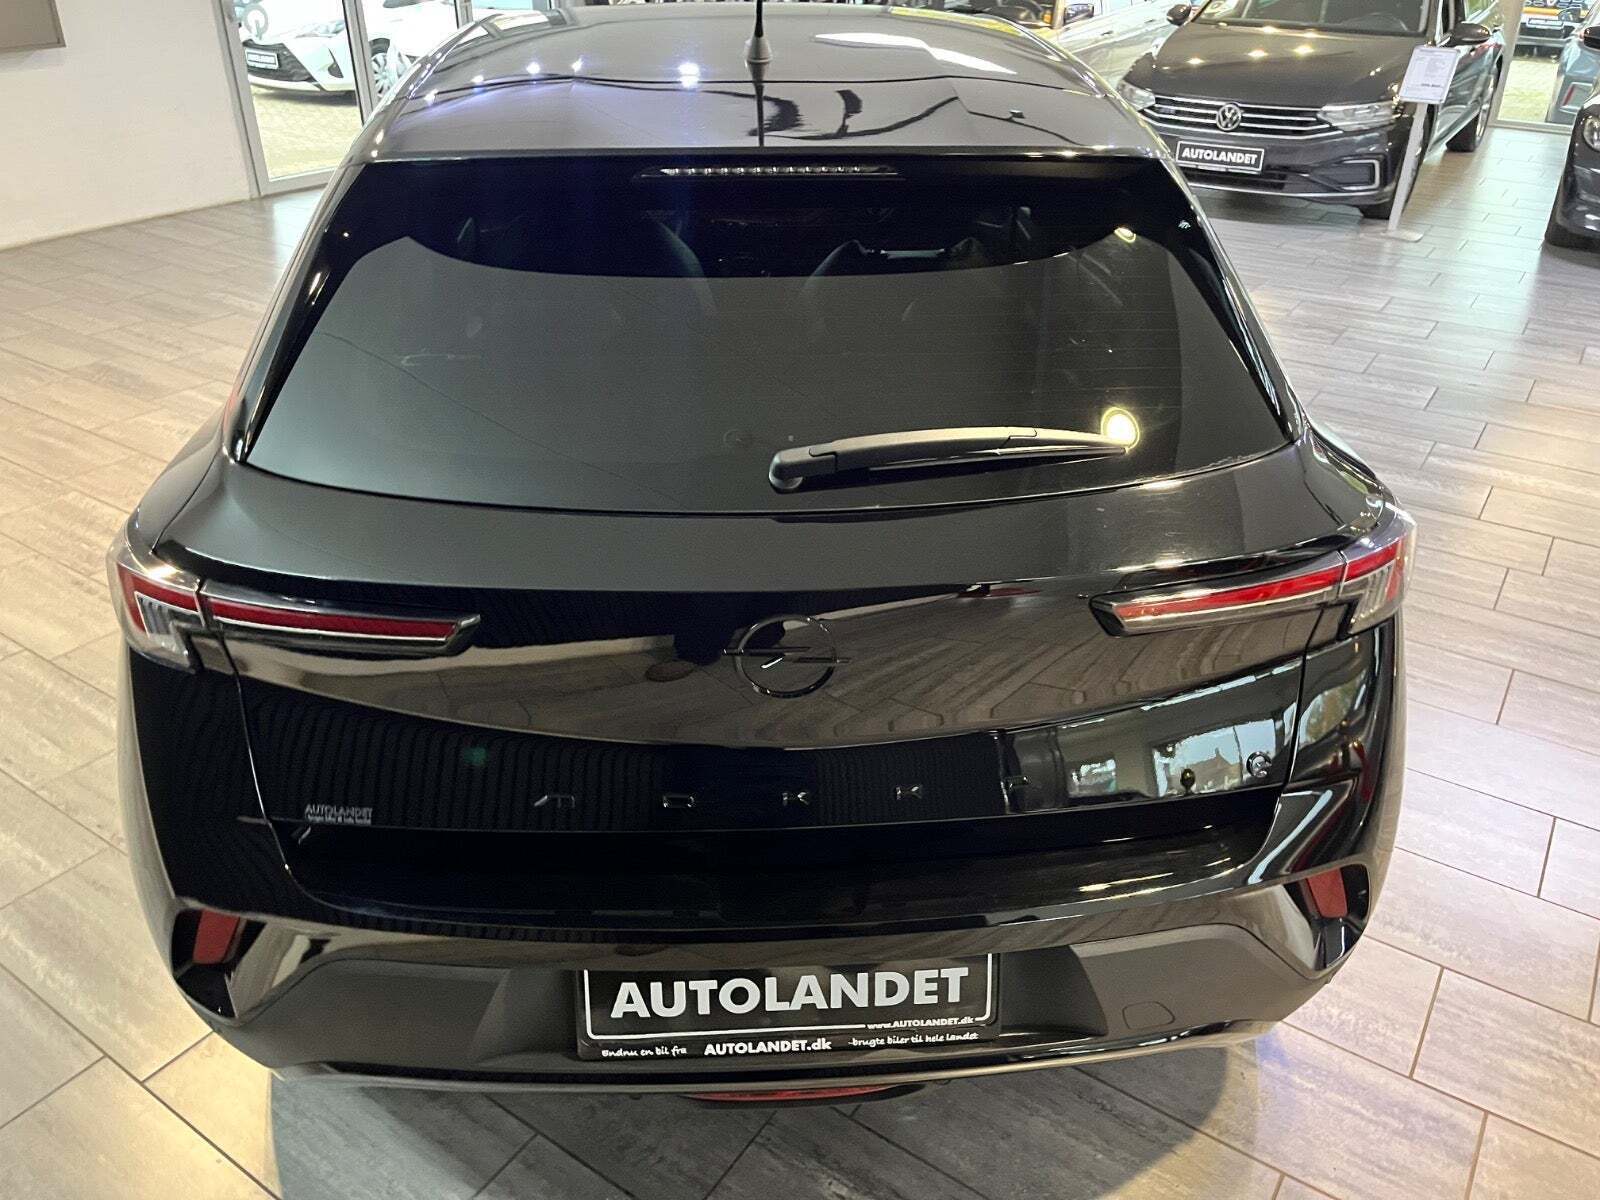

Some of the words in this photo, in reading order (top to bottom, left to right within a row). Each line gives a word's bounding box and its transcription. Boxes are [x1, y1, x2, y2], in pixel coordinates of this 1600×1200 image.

[1181, 147, 1258, 165] AUTOLANDET
[304, 804, 373, 817] AUTOLANDET
[610, 967, 970, 1019] AUTOLANDET
[866, 1016, 974, 1029] www.AUTOLANDET.dk
[655, 1046, 669, 1056] bil
[671, 1045, 687, 1057] fra
[704, 1037, 832, 1056] AUTOLANDET.dk
[887, 1036, 910, 1045] biler
[911, 1034, 924, 1043] til
[925, 1034, 944, 1042] hele
